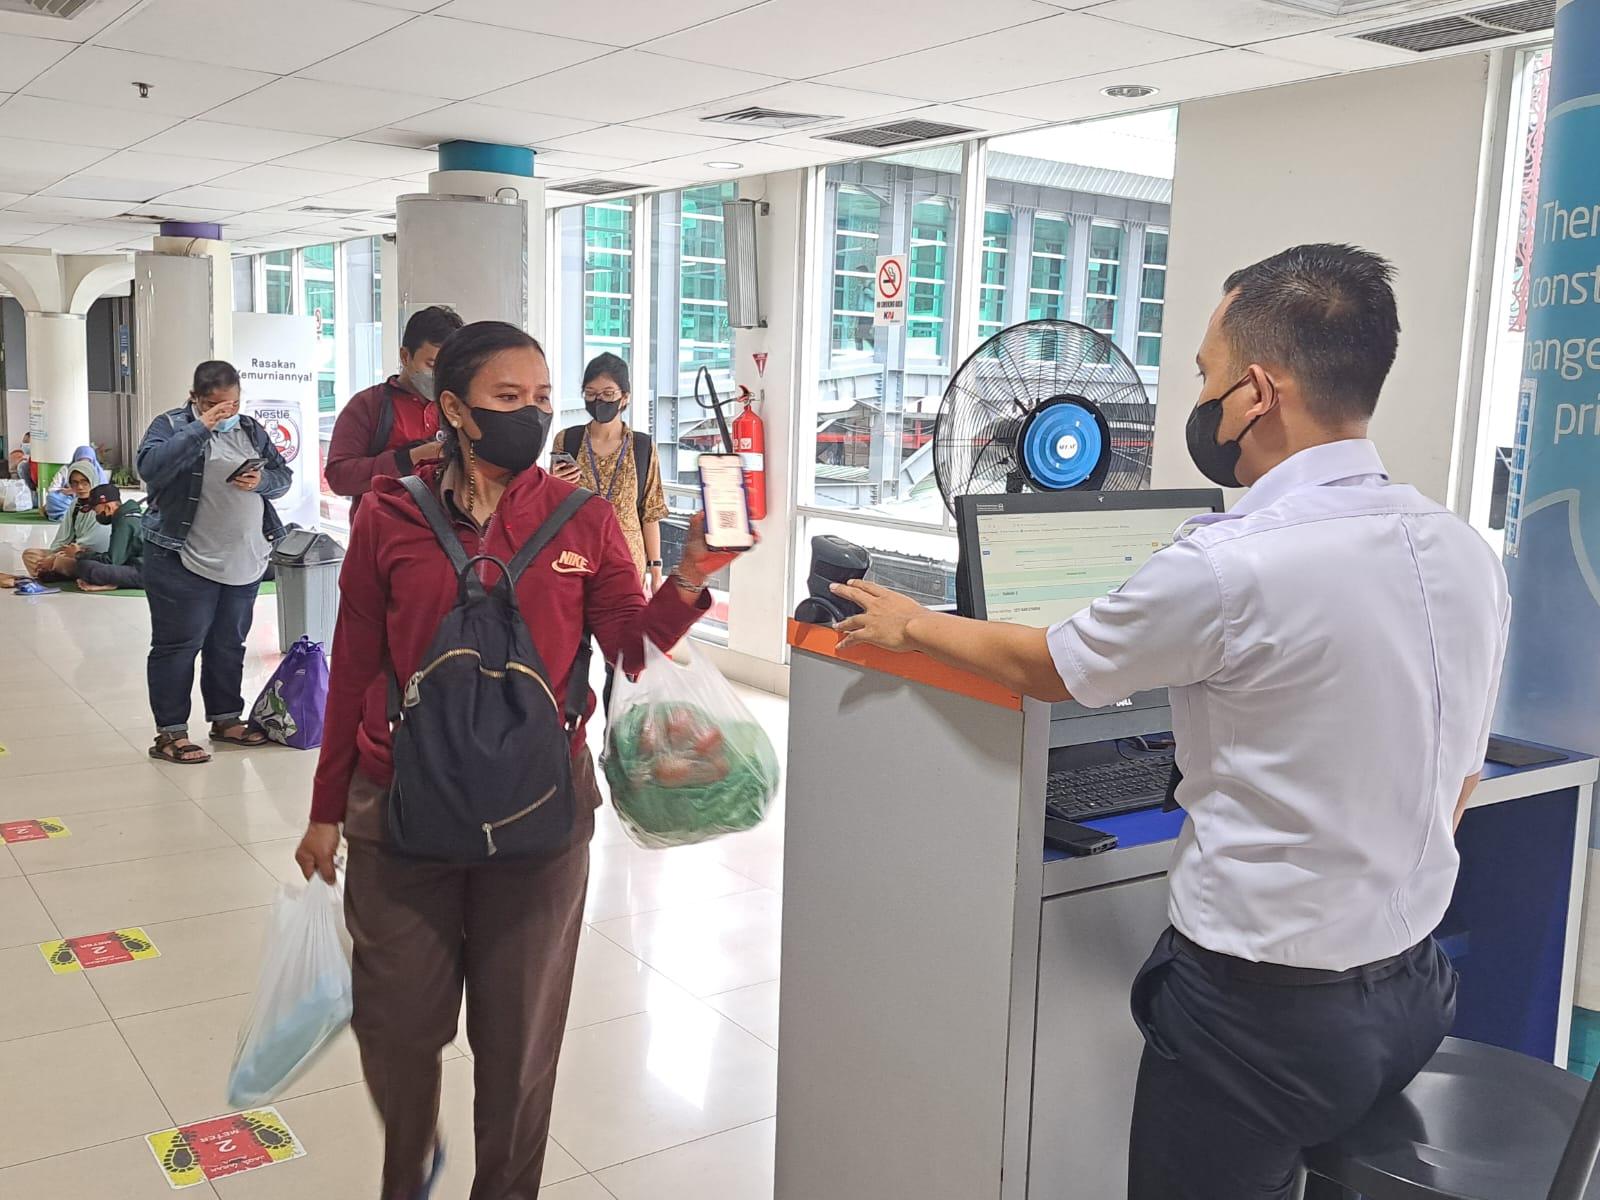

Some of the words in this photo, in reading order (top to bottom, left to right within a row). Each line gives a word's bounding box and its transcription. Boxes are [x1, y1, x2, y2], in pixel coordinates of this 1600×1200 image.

[1532, 264, 1600, 308] const
[251, 358, 296, 370] Rasakan
[559, 550, 589, 569] NIKE
[91, 945, 108, 955] 2
[200, 1128, 240, 1143] METER
[214, 1138, 238, 1153] 2
